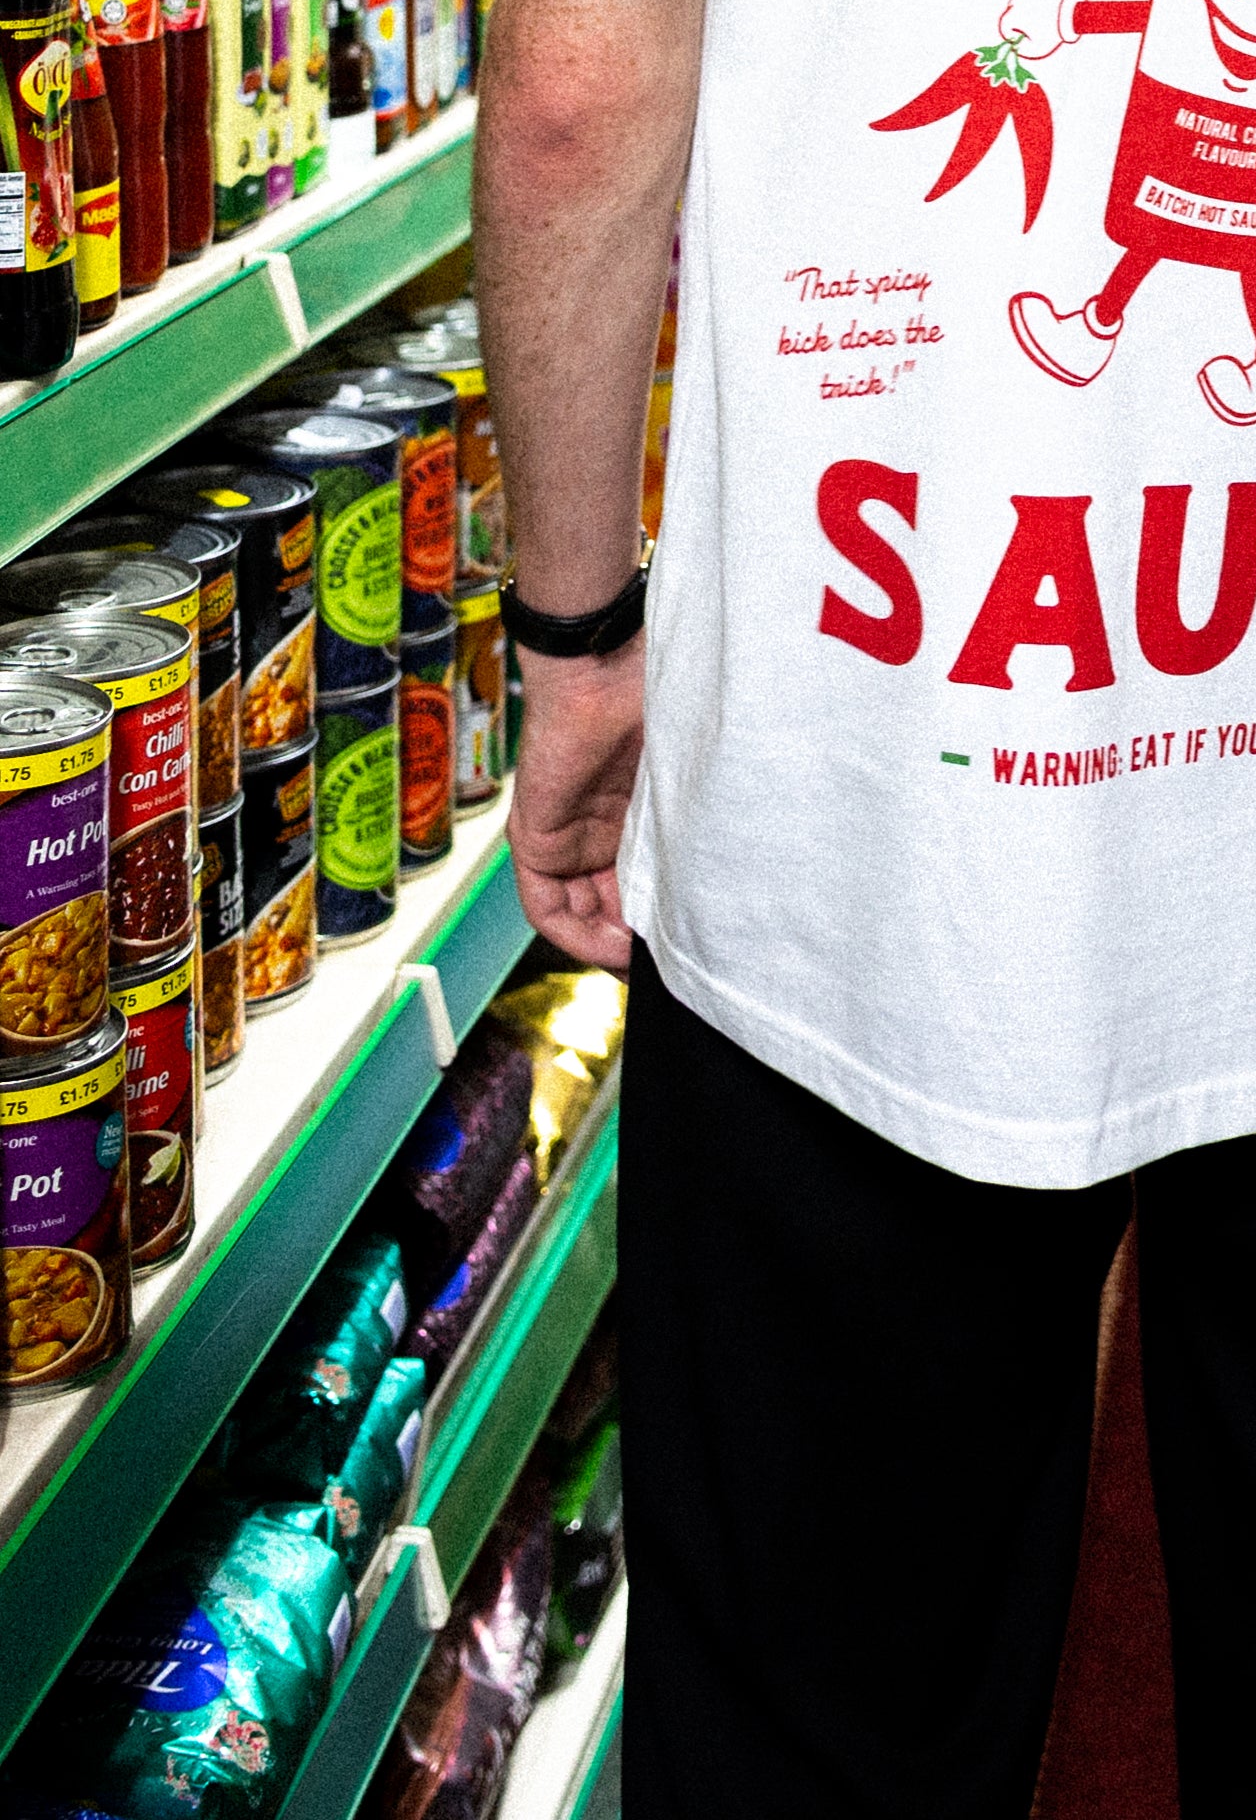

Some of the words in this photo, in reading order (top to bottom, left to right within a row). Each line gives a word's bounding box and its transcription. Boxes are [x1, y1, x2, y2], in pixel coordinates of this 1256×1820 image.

[1174, 108, 1238, 142] NATURAL
[1198, 203, 1226, 225] HOT
[864, 268, 932, 304] spicy
[777, 321, 833, 355] kick
[839, 319, 897, 350] does
[905, 313, 945, 344] the
[150, 668, 179, 692] £1.75
[146, 719, 184, 758] Chilli
[60, 747, 95, 773] £1.75
[992, 744, 1124, 787] WARNING:
[1130, 732, 1177, 772] EAT
[1185, 728, 1207, 764] IF
[1, 766, 31, 783] .75
[118, 769, 158, 795] Con
[27, 827, 76, 867] Hot
[25, 889, 34, 900] A
[37, 876, 79, 897] Warming
[161, 970, 187, 997] £1.75
[59, 1077, 100, 1106] £1.75
[126, 1070, 170, 1102] arne
[0, 1101, 28, 1118] .75
[0, 1133, 38, 1150] -one
[10, 1165, 64, 1202] Pot
[11, 1222, 40, 1236] Tasty
[40, 1213, 67, 1230] Meal
